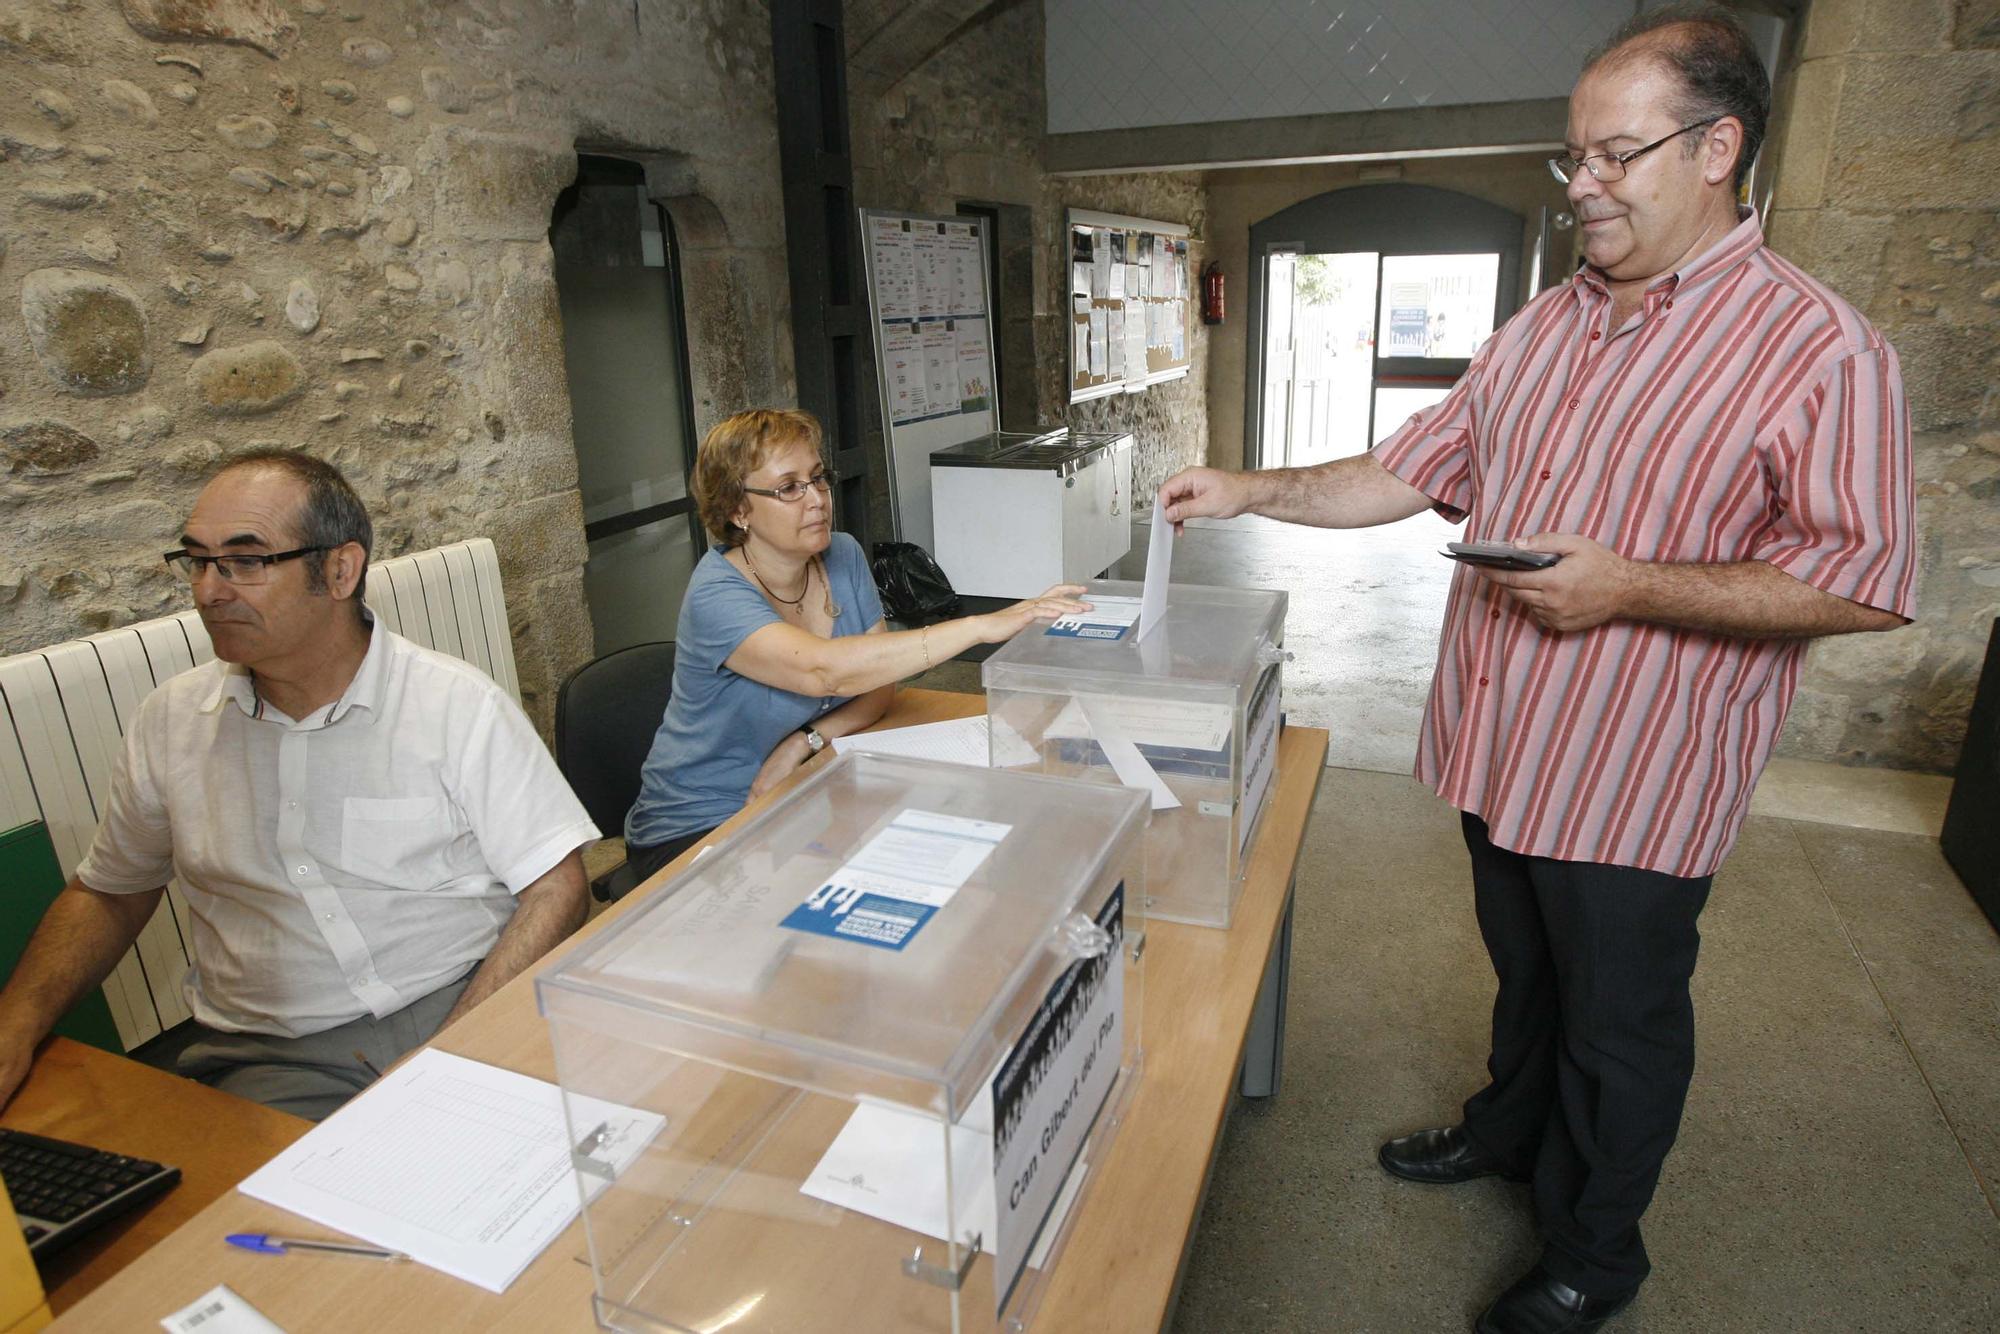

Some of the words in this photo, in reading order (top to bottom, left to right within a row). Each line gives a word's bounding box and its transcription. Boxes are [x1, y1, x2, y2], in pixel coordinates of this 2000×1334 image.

[1009, 1156, 1038, 1211] Can
[1041, 1078, 1079, 1154] Gibert
[1081, 1039, 1098, 1083] del
[1098, 1011, 1115, 1049] Pla
